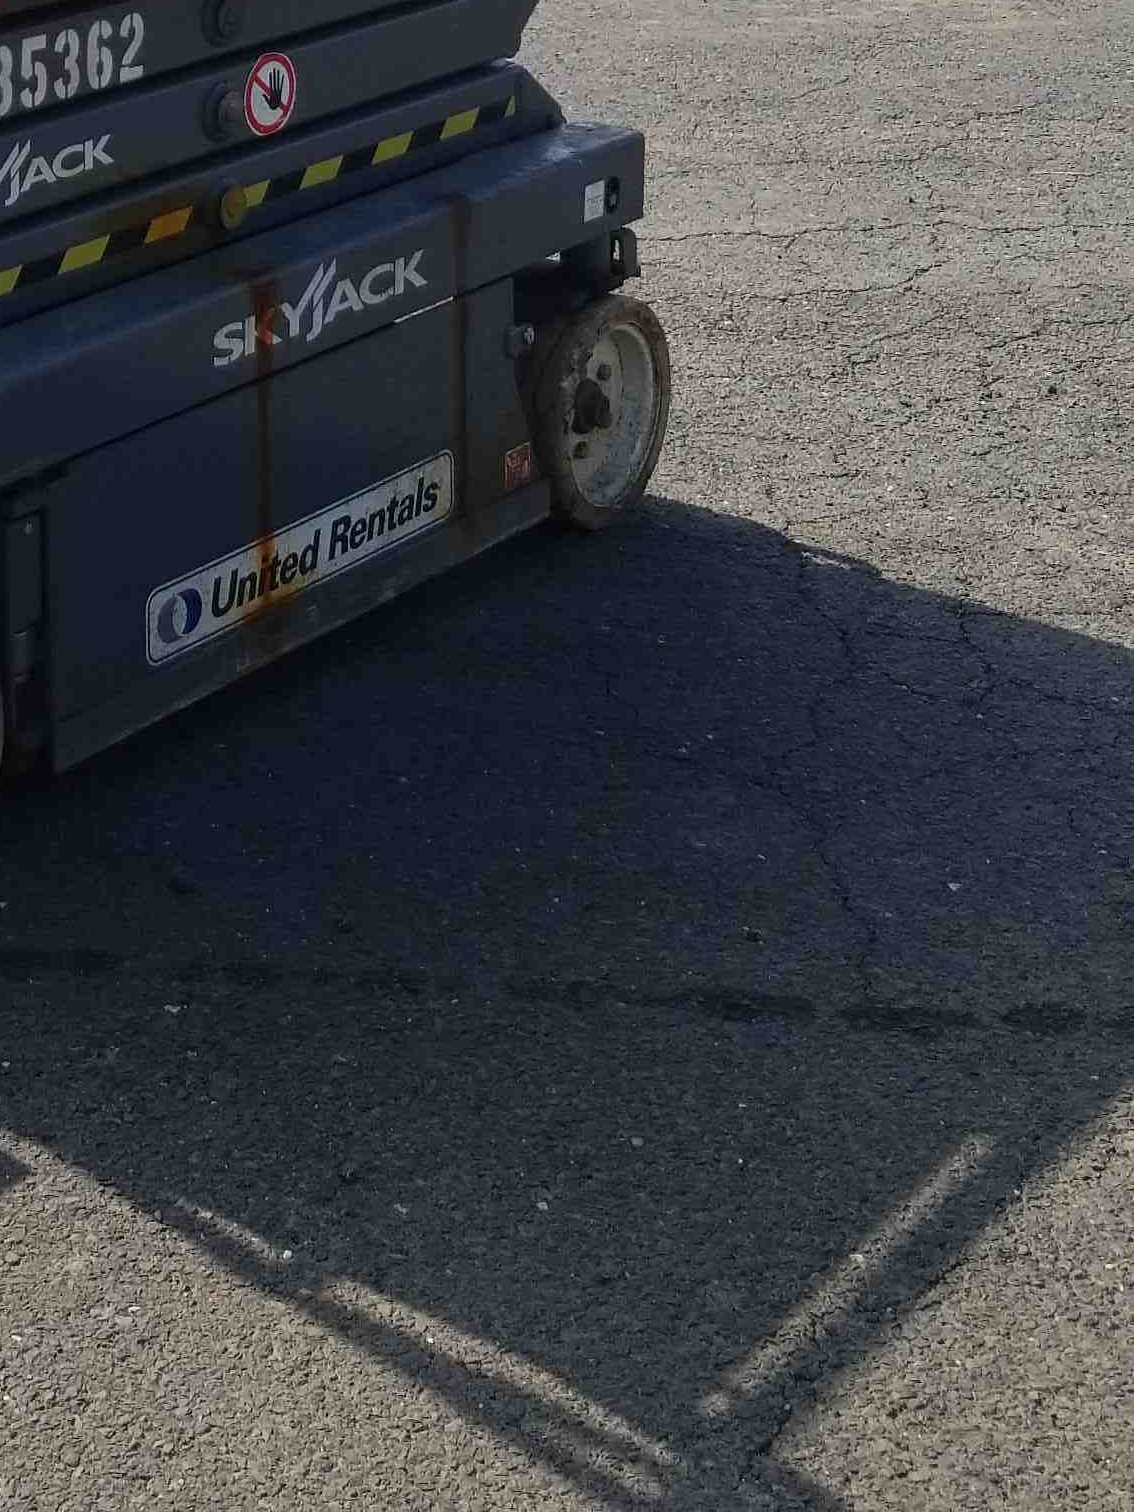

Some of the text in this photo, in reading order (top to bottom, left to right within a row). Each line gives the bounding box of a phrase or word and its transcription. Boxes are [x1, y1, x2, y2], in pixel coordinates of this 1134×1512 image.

[212, 248, 428, 368] SKYJACK
[210, 477, 440, 618] United Rentals
